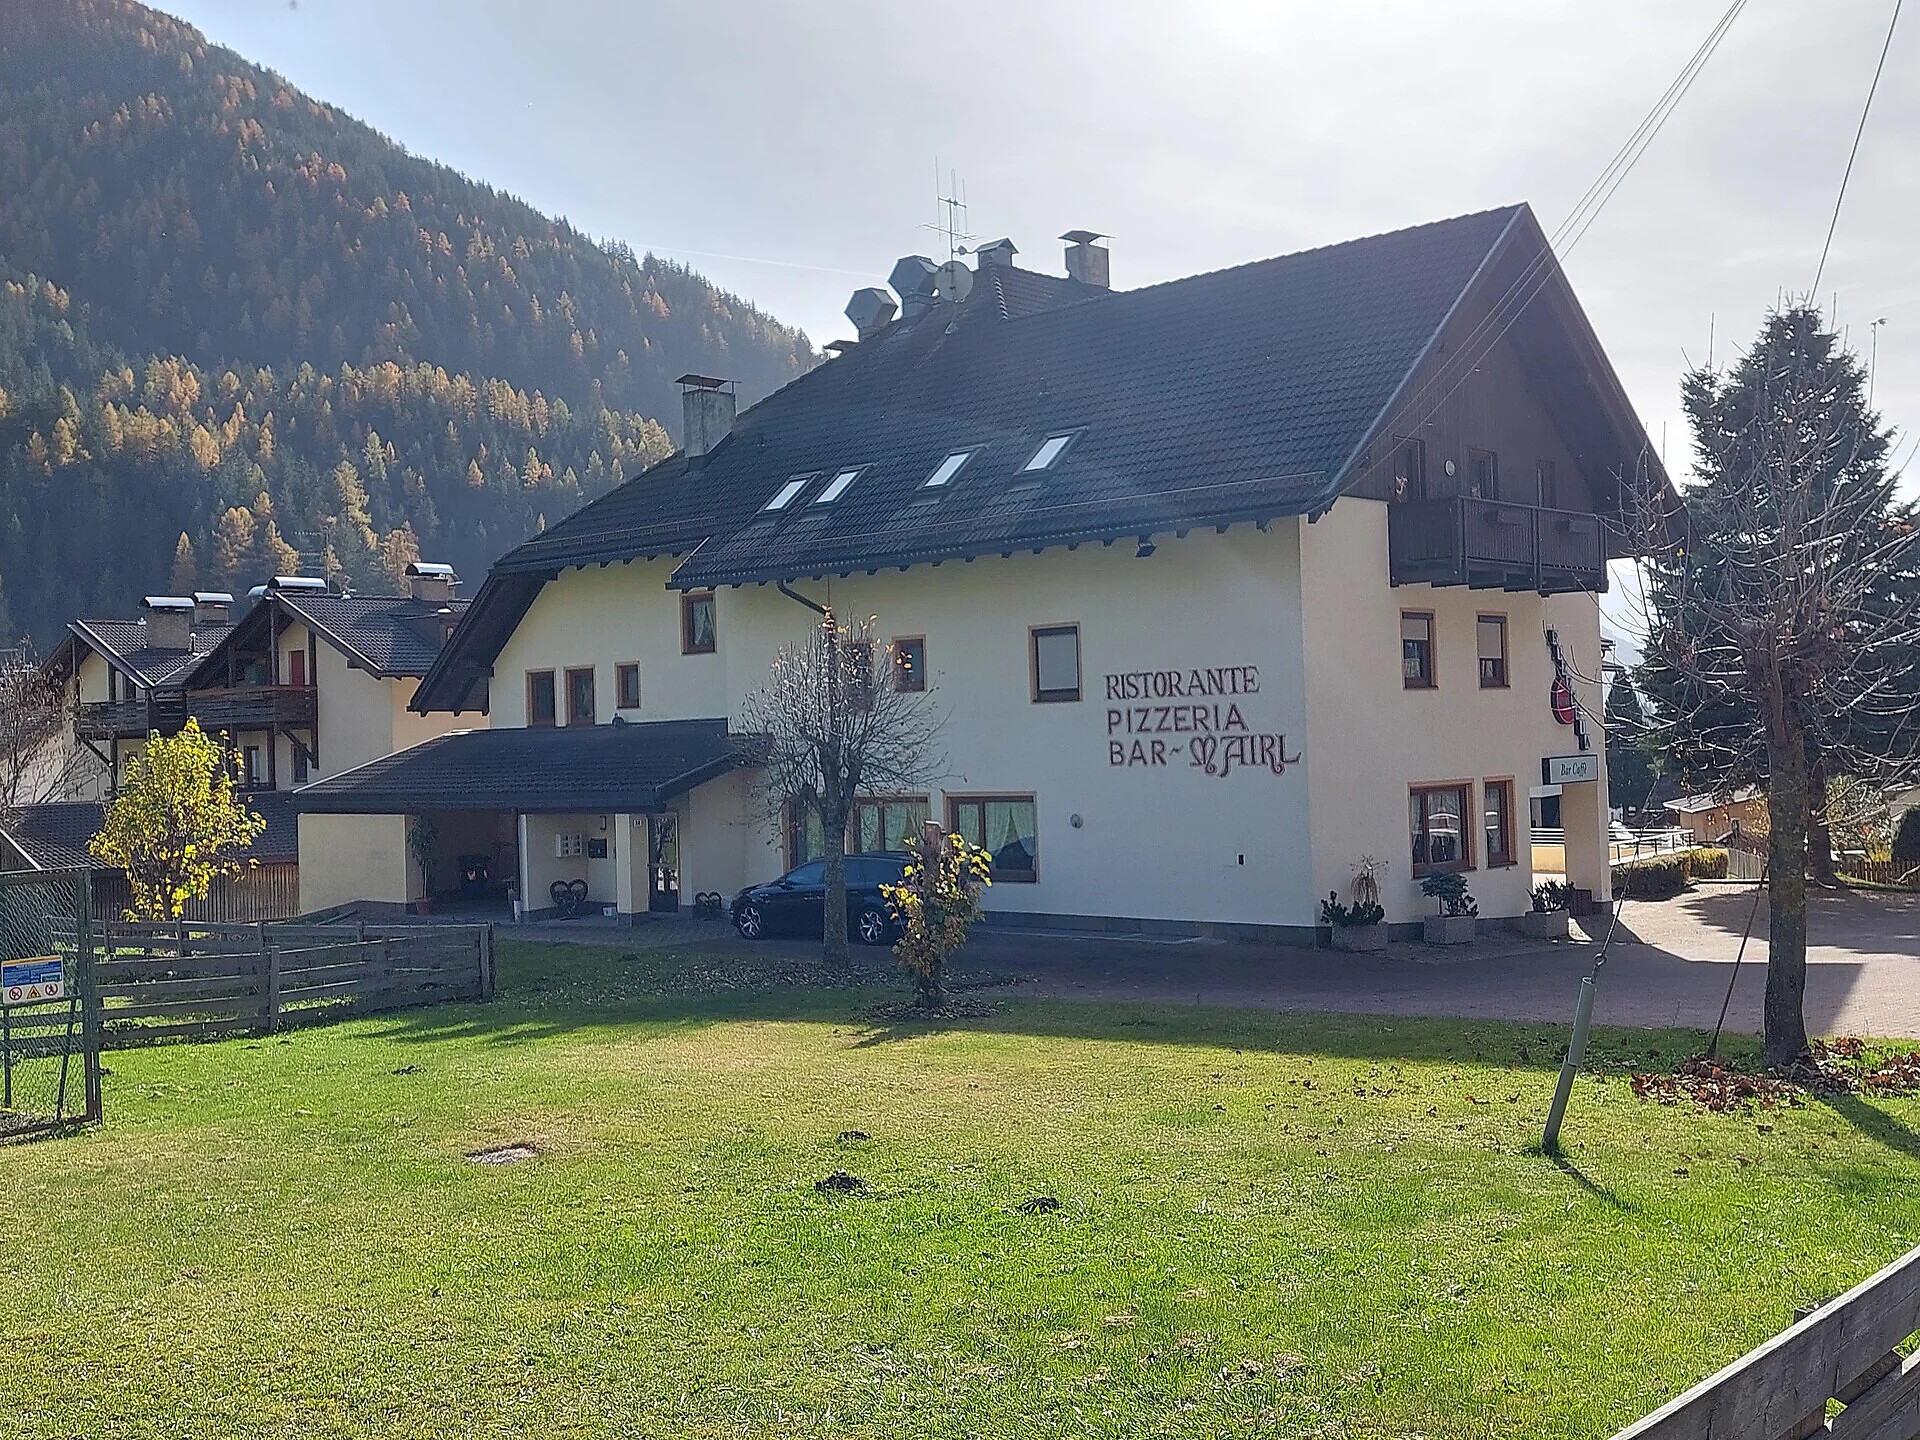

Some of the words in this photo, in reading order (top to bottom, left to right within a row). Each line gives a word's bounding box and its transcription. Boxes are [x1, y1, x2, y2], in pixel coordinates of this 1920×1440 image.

[1105, 665, 1260, 700] RISTORANTE
[1107, 702, 1250, 734] PIZZERIA
[1560, 763, 1572, 776] Bar
